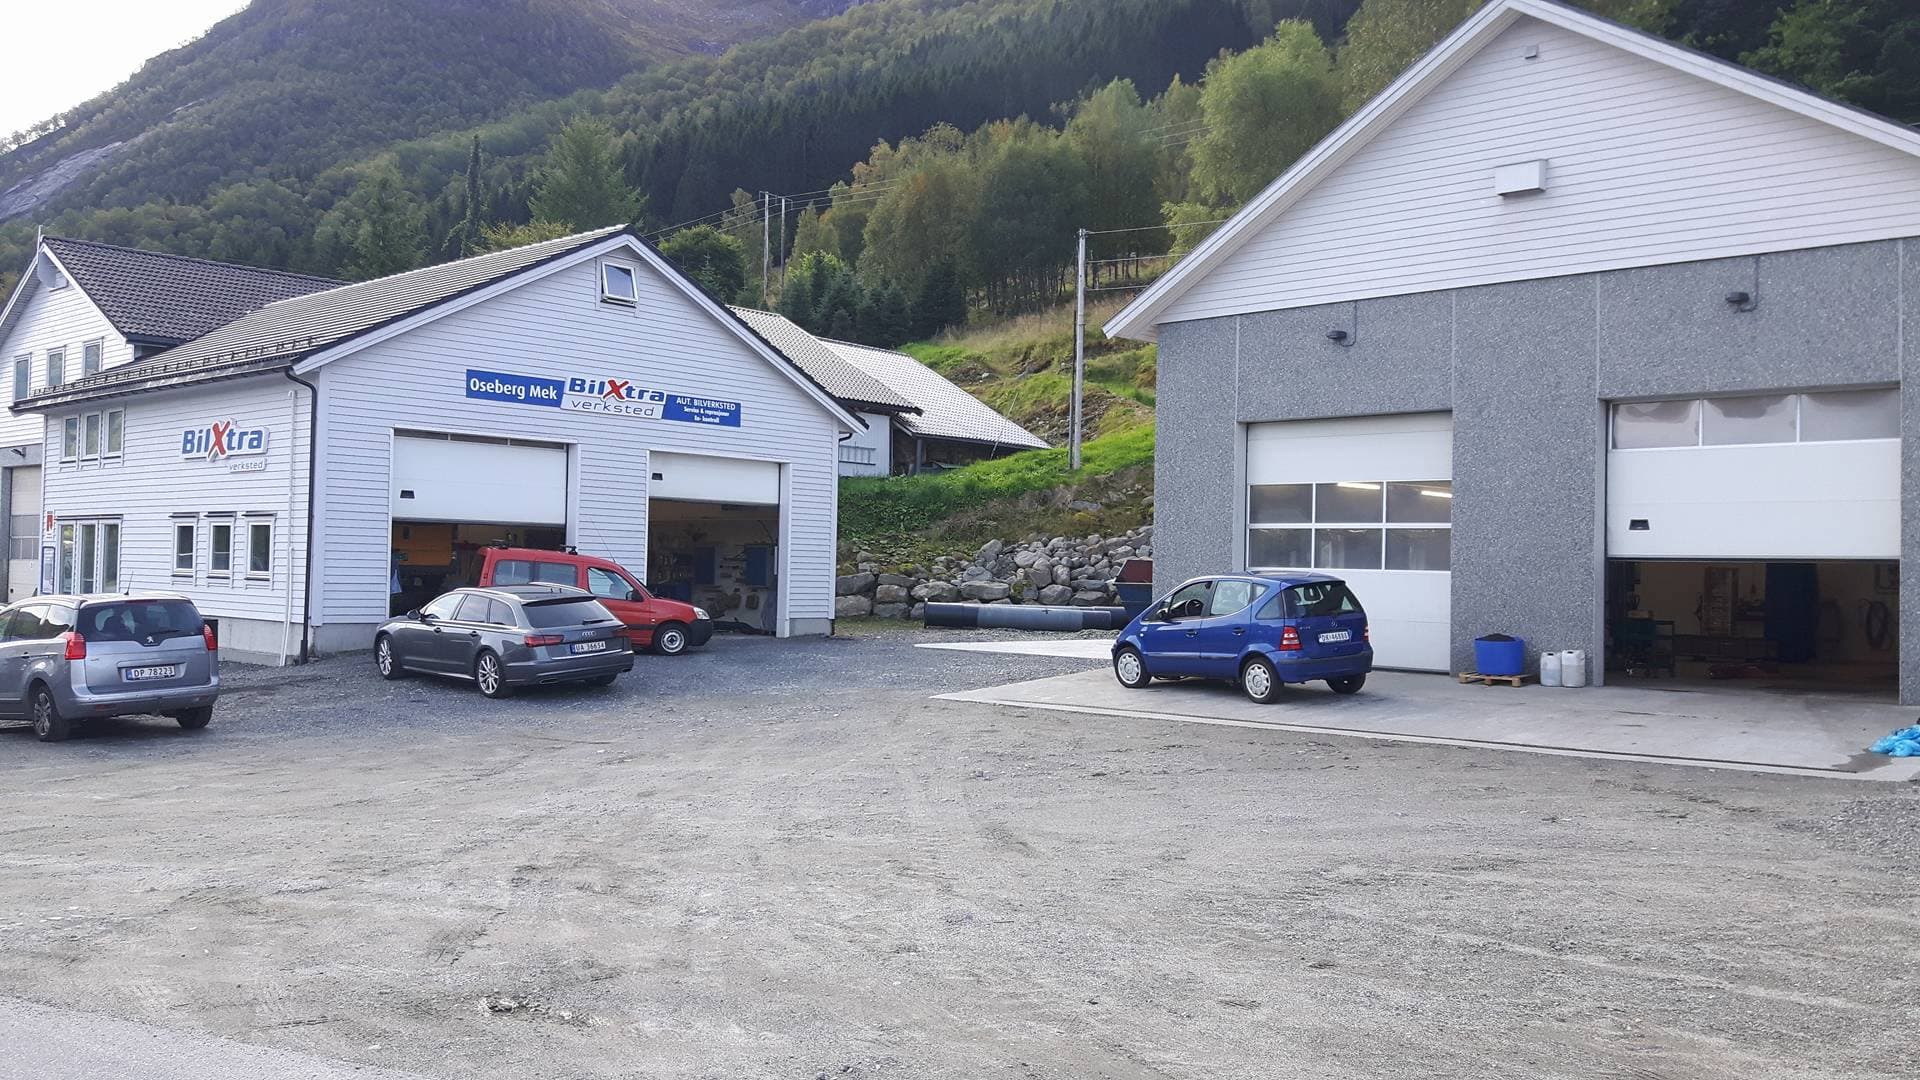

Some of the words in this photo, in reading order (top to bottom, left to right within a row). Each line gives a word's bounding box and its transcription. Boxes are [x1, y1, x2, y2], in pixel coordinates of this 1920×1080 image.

[470, 378, 525, 399] Oseberg
[529, 385, 557, 400] Mek
[568, 378, 665, 402] BilXtra
[571, 400, 655, 417] verksted
[676, 397, 691, 405] AUT.
[693, 399, 736, 410] BILVERKSTED
[181, 421, 264, 458] BilXtra
[229, 461, 264, 471] verksted
[134, 669, 145, 677] DP
[148, 667, 173, 676] 78223
